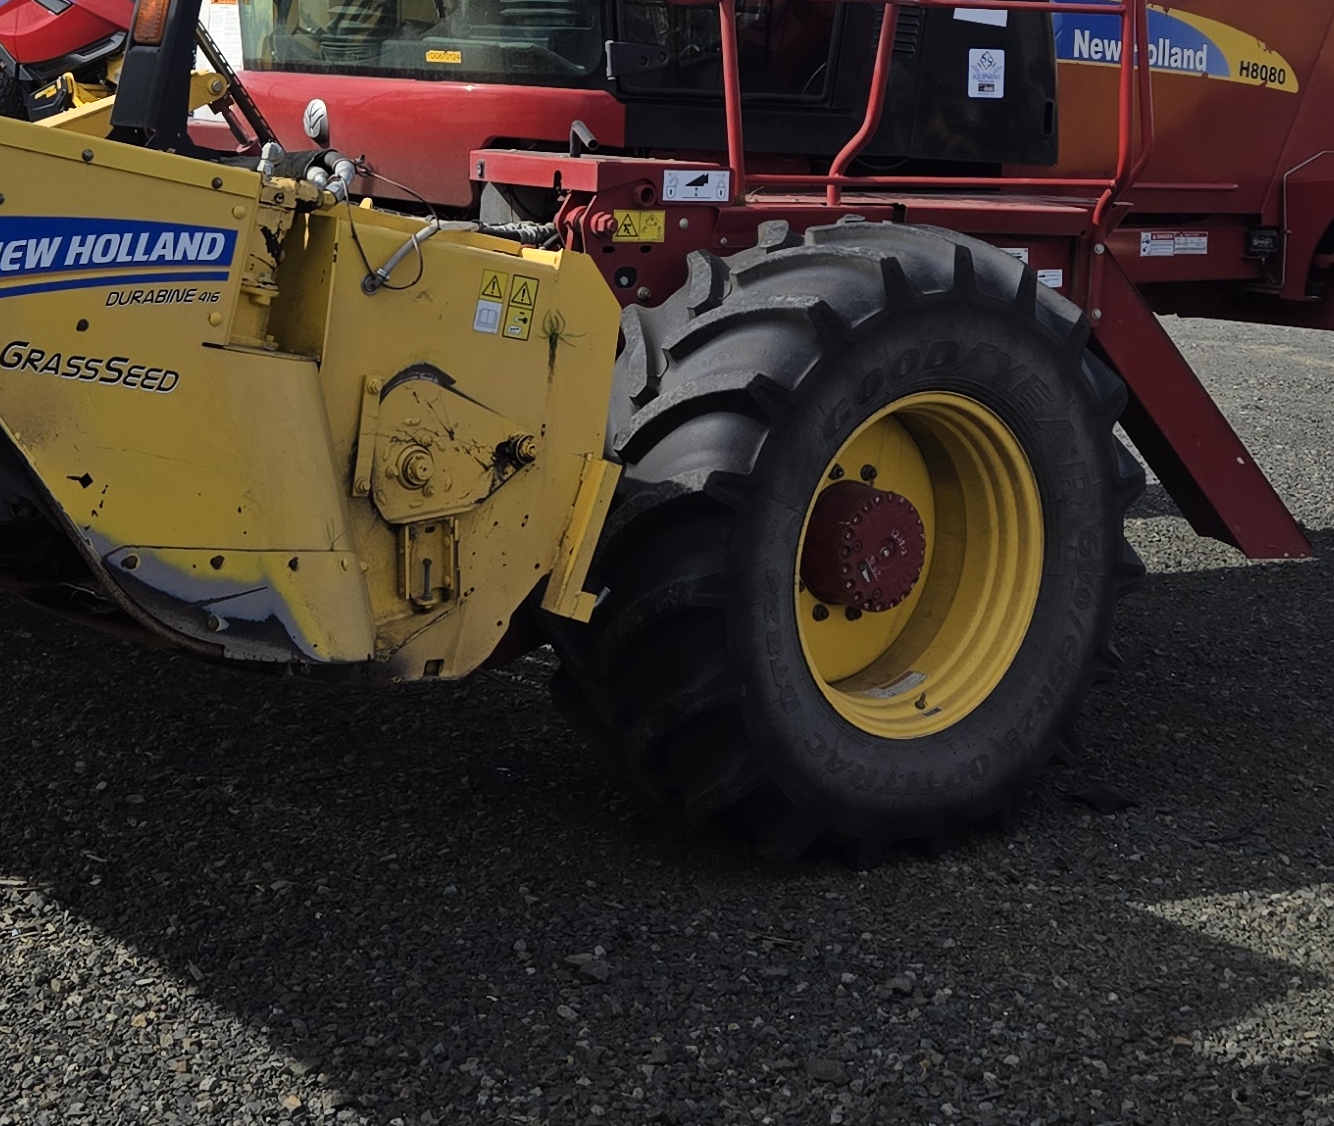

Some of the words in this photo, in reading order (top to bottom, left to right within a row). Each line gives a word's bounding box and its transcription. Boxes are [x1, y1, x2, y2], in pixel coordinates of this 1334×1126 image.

[1073, 28, 1123, 61] New
[1133, 37, 1208, 72] olland
[1239, 59, 1286, 85] H8080
[64, 232, 226, 266] HOLLAND
[105, 289, 198, 307] DURABINE
[198, 291, 221, 303] 416
